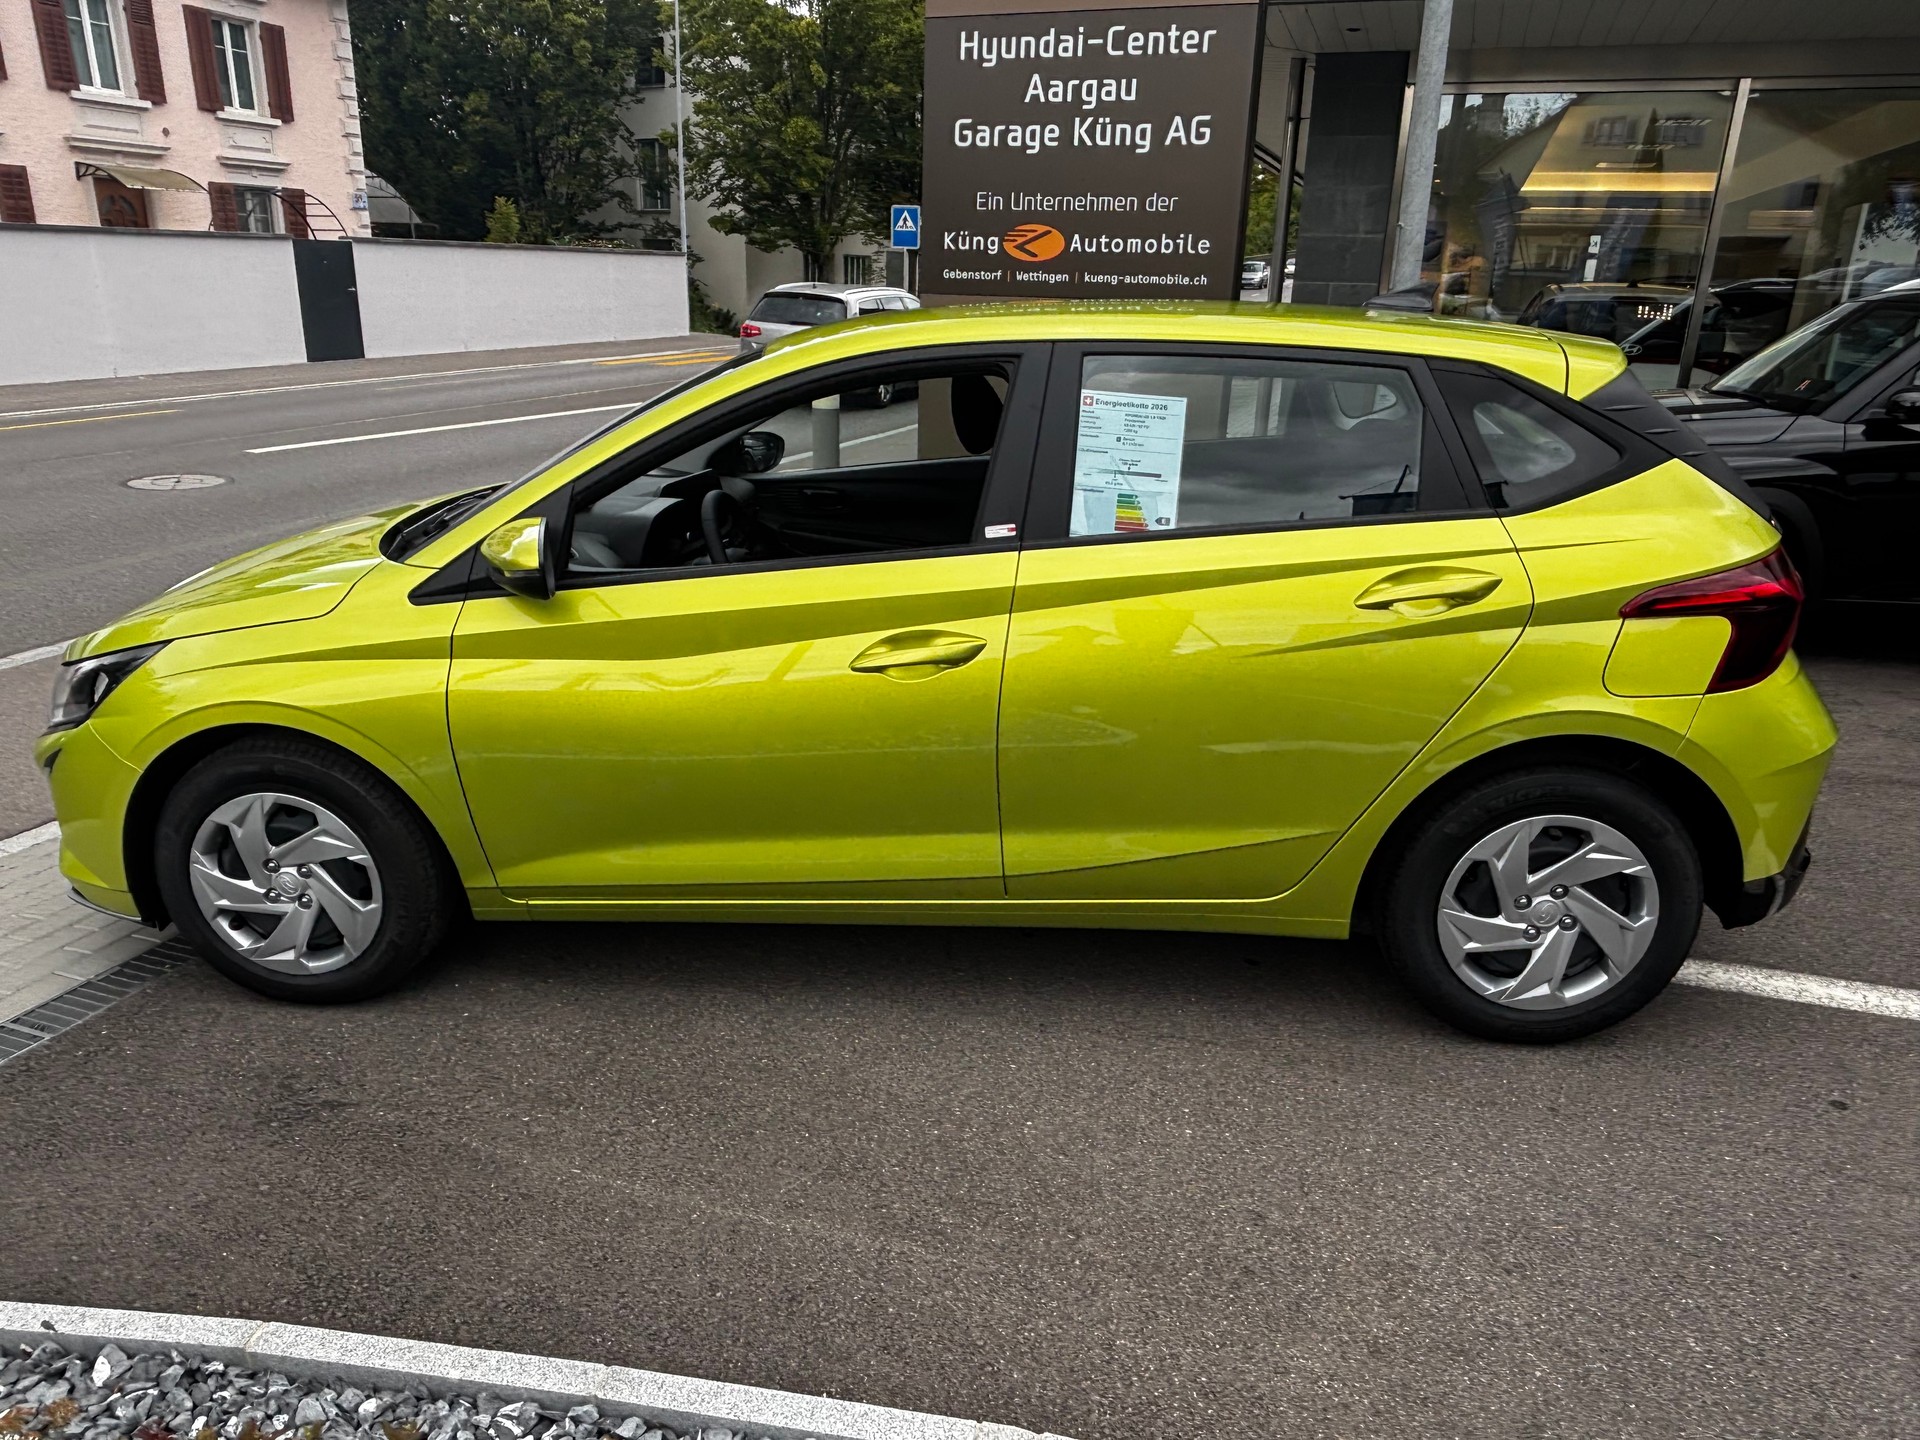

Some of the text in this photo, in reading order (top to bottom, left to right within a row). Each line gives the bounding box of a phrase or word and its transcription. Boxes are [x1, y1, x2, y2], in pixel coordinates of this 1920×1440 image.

[960, 24, 1217, 67] Hyundai-Center
[1024, 73, 1137, 109] Aargau
[954, 115, 1211, 154] Garage Küng AG
[976, 191, 1179, 212] Ein Unternehmen der
[944, 231, 1211, 255] Küng Automobile
[943, 268, 1208, 286] Gebenstorf Wettingen kueng-automobile.ch
[1150, 403, 1168, 411] 2026
